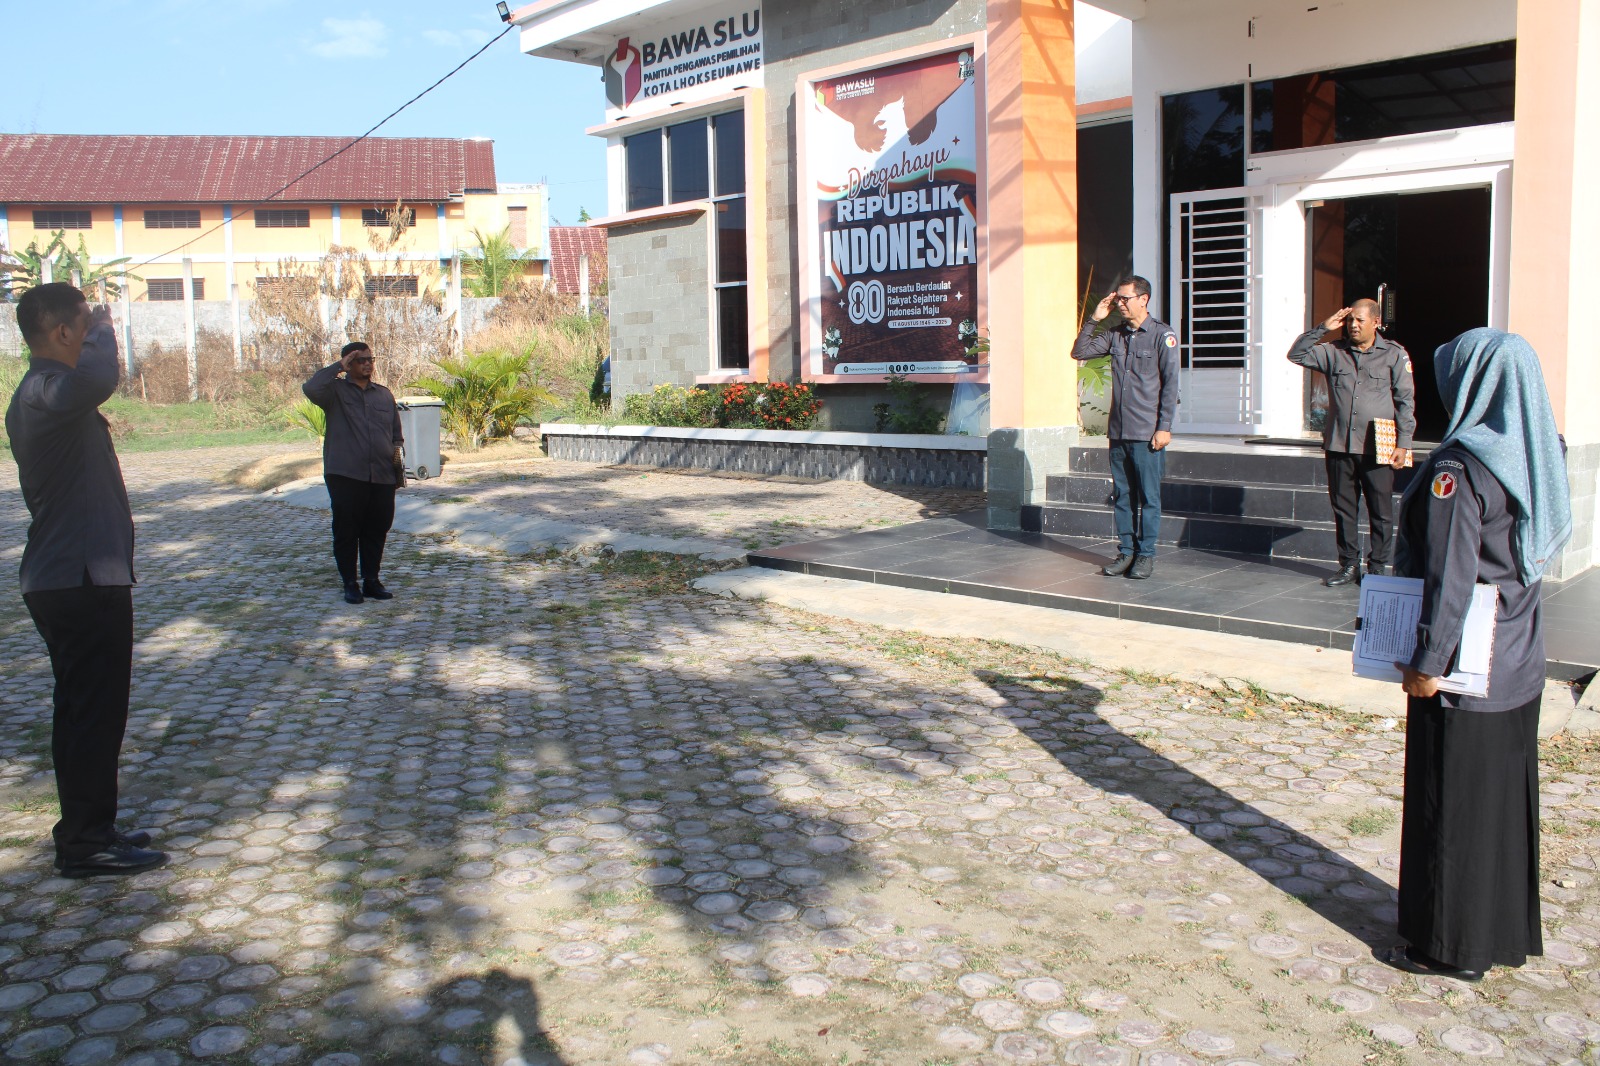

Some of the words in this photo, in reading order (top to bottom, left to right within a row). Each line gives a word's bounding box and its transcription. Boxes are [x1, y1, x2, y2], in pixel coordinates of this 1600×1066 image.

[642, 9, 760, 67] BAWASLU
[643, 66, 673, 83] PANITIA
[673, 54, 717, 75] PENGAWAS
[717, 42, 760, 63] PEMILIHAN
[644, 81, 671, 98] KOTA
[673, 58, 761, 91] LHOKSEUMAWE
[836, 77, 875, 94] BAWASLU
[847, 147, 950, 199] Dirgahayu
[837, 184, 960, 223] REPUBLIK
[823, 215, 977, 277] INDONESIA
[848, 279, 885, 325] 80
[887, 284, 915, 294] Bersatu
[915, 280, 952, 292] Berdaulat
[887, 295, 912, 306] Rakyat
[912, 293, 948, 306] Sejahtera
[887, 307, 922, 317] Indonesia
[922, 305, 940, 317] Maju
